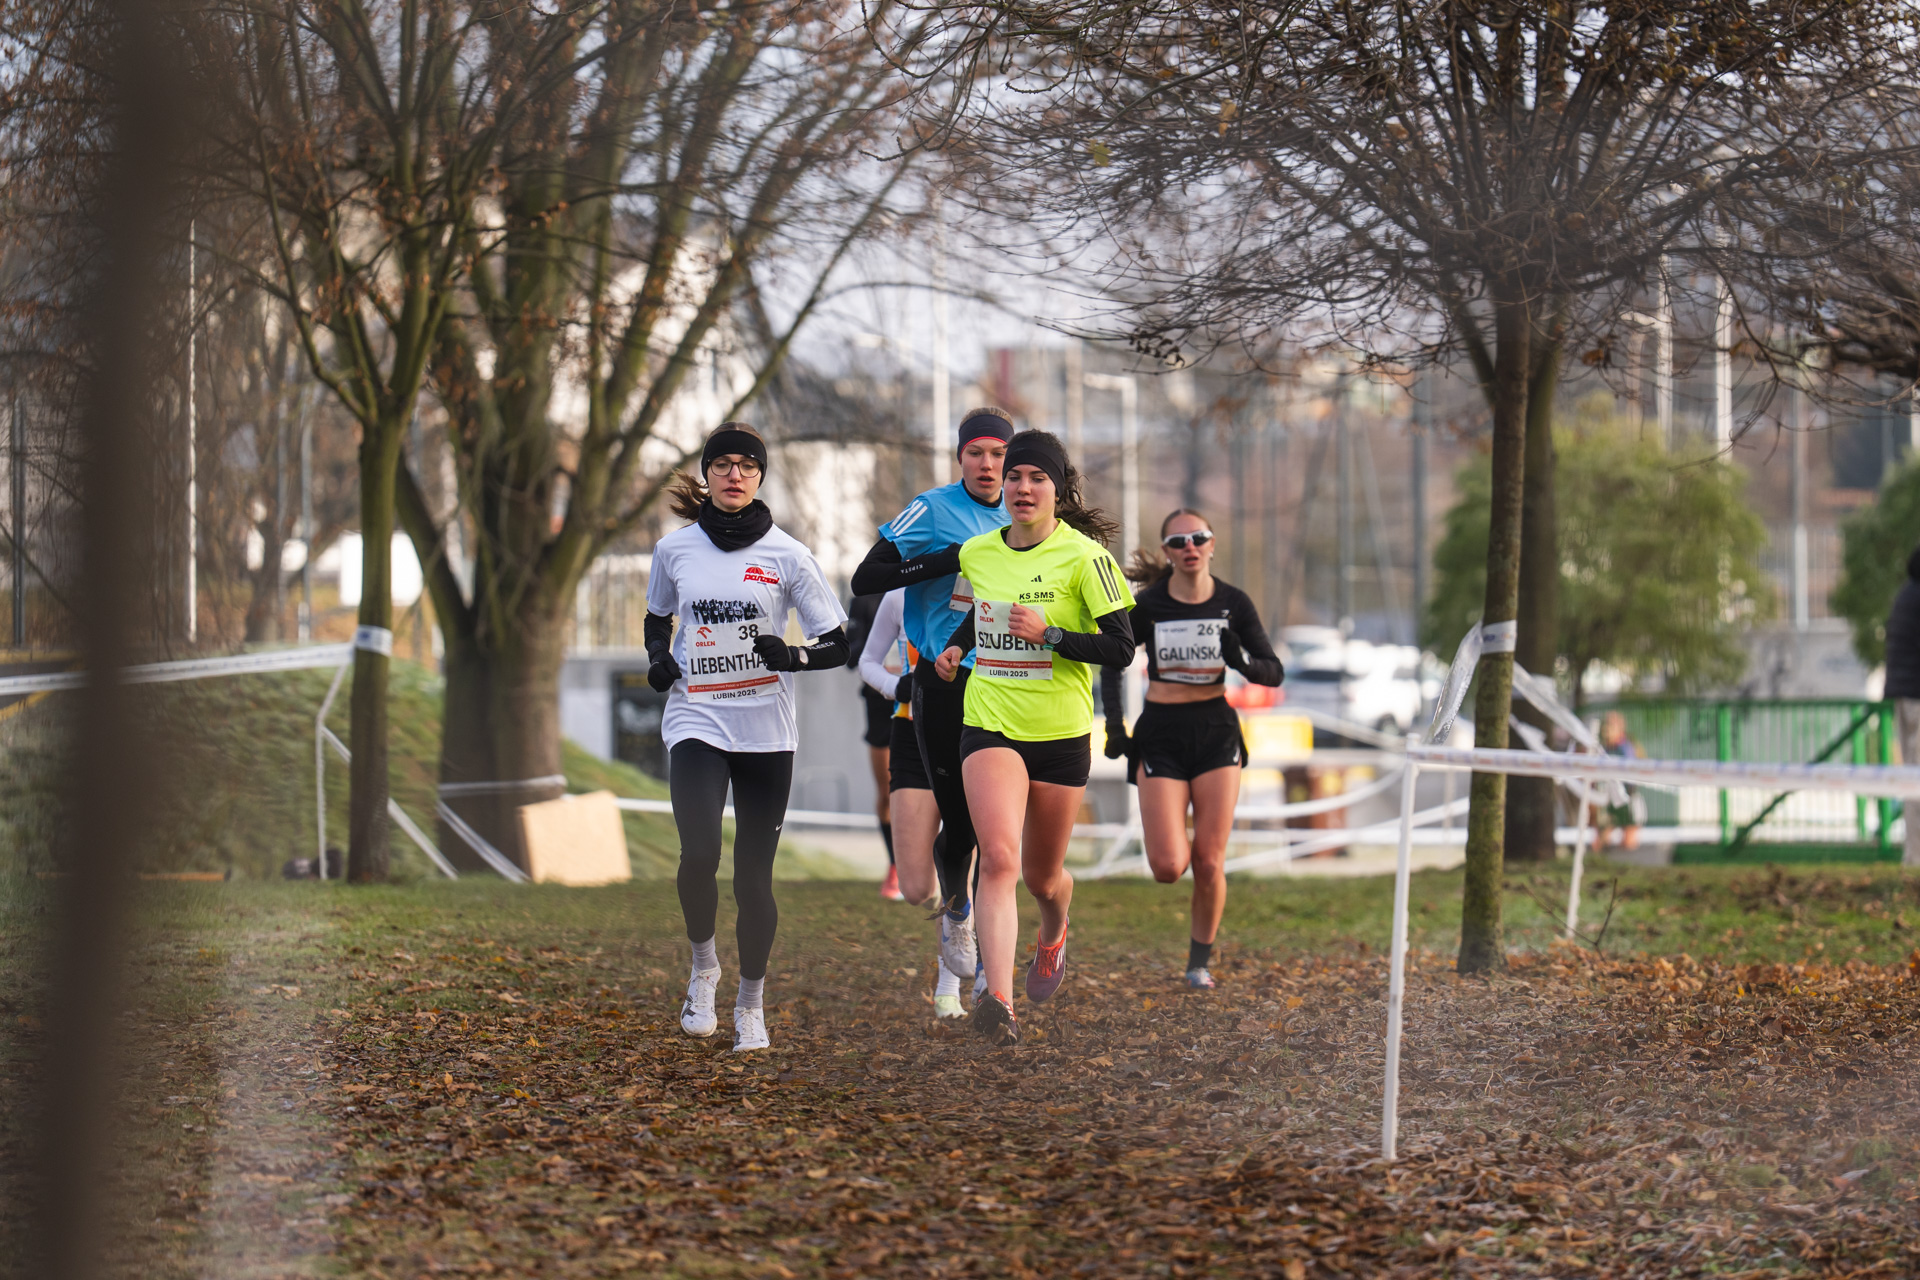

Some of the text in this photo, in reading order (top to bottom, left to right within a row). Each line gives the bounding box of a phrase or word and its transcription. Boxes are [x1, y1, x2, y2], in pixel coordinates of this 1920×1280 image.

[1019, 591, 1055, 600] KS SMS
[979, 615, 994, 623] ORLEN
[738, 624, 759, 640] 38
[1197, 623, 1222, 636] 261
[978, 631, 1045, 651] SZUBER
[989, 669, 1029, 678] LUBIN 2025
[712, 688, 757, 700] LUBIN 2025
